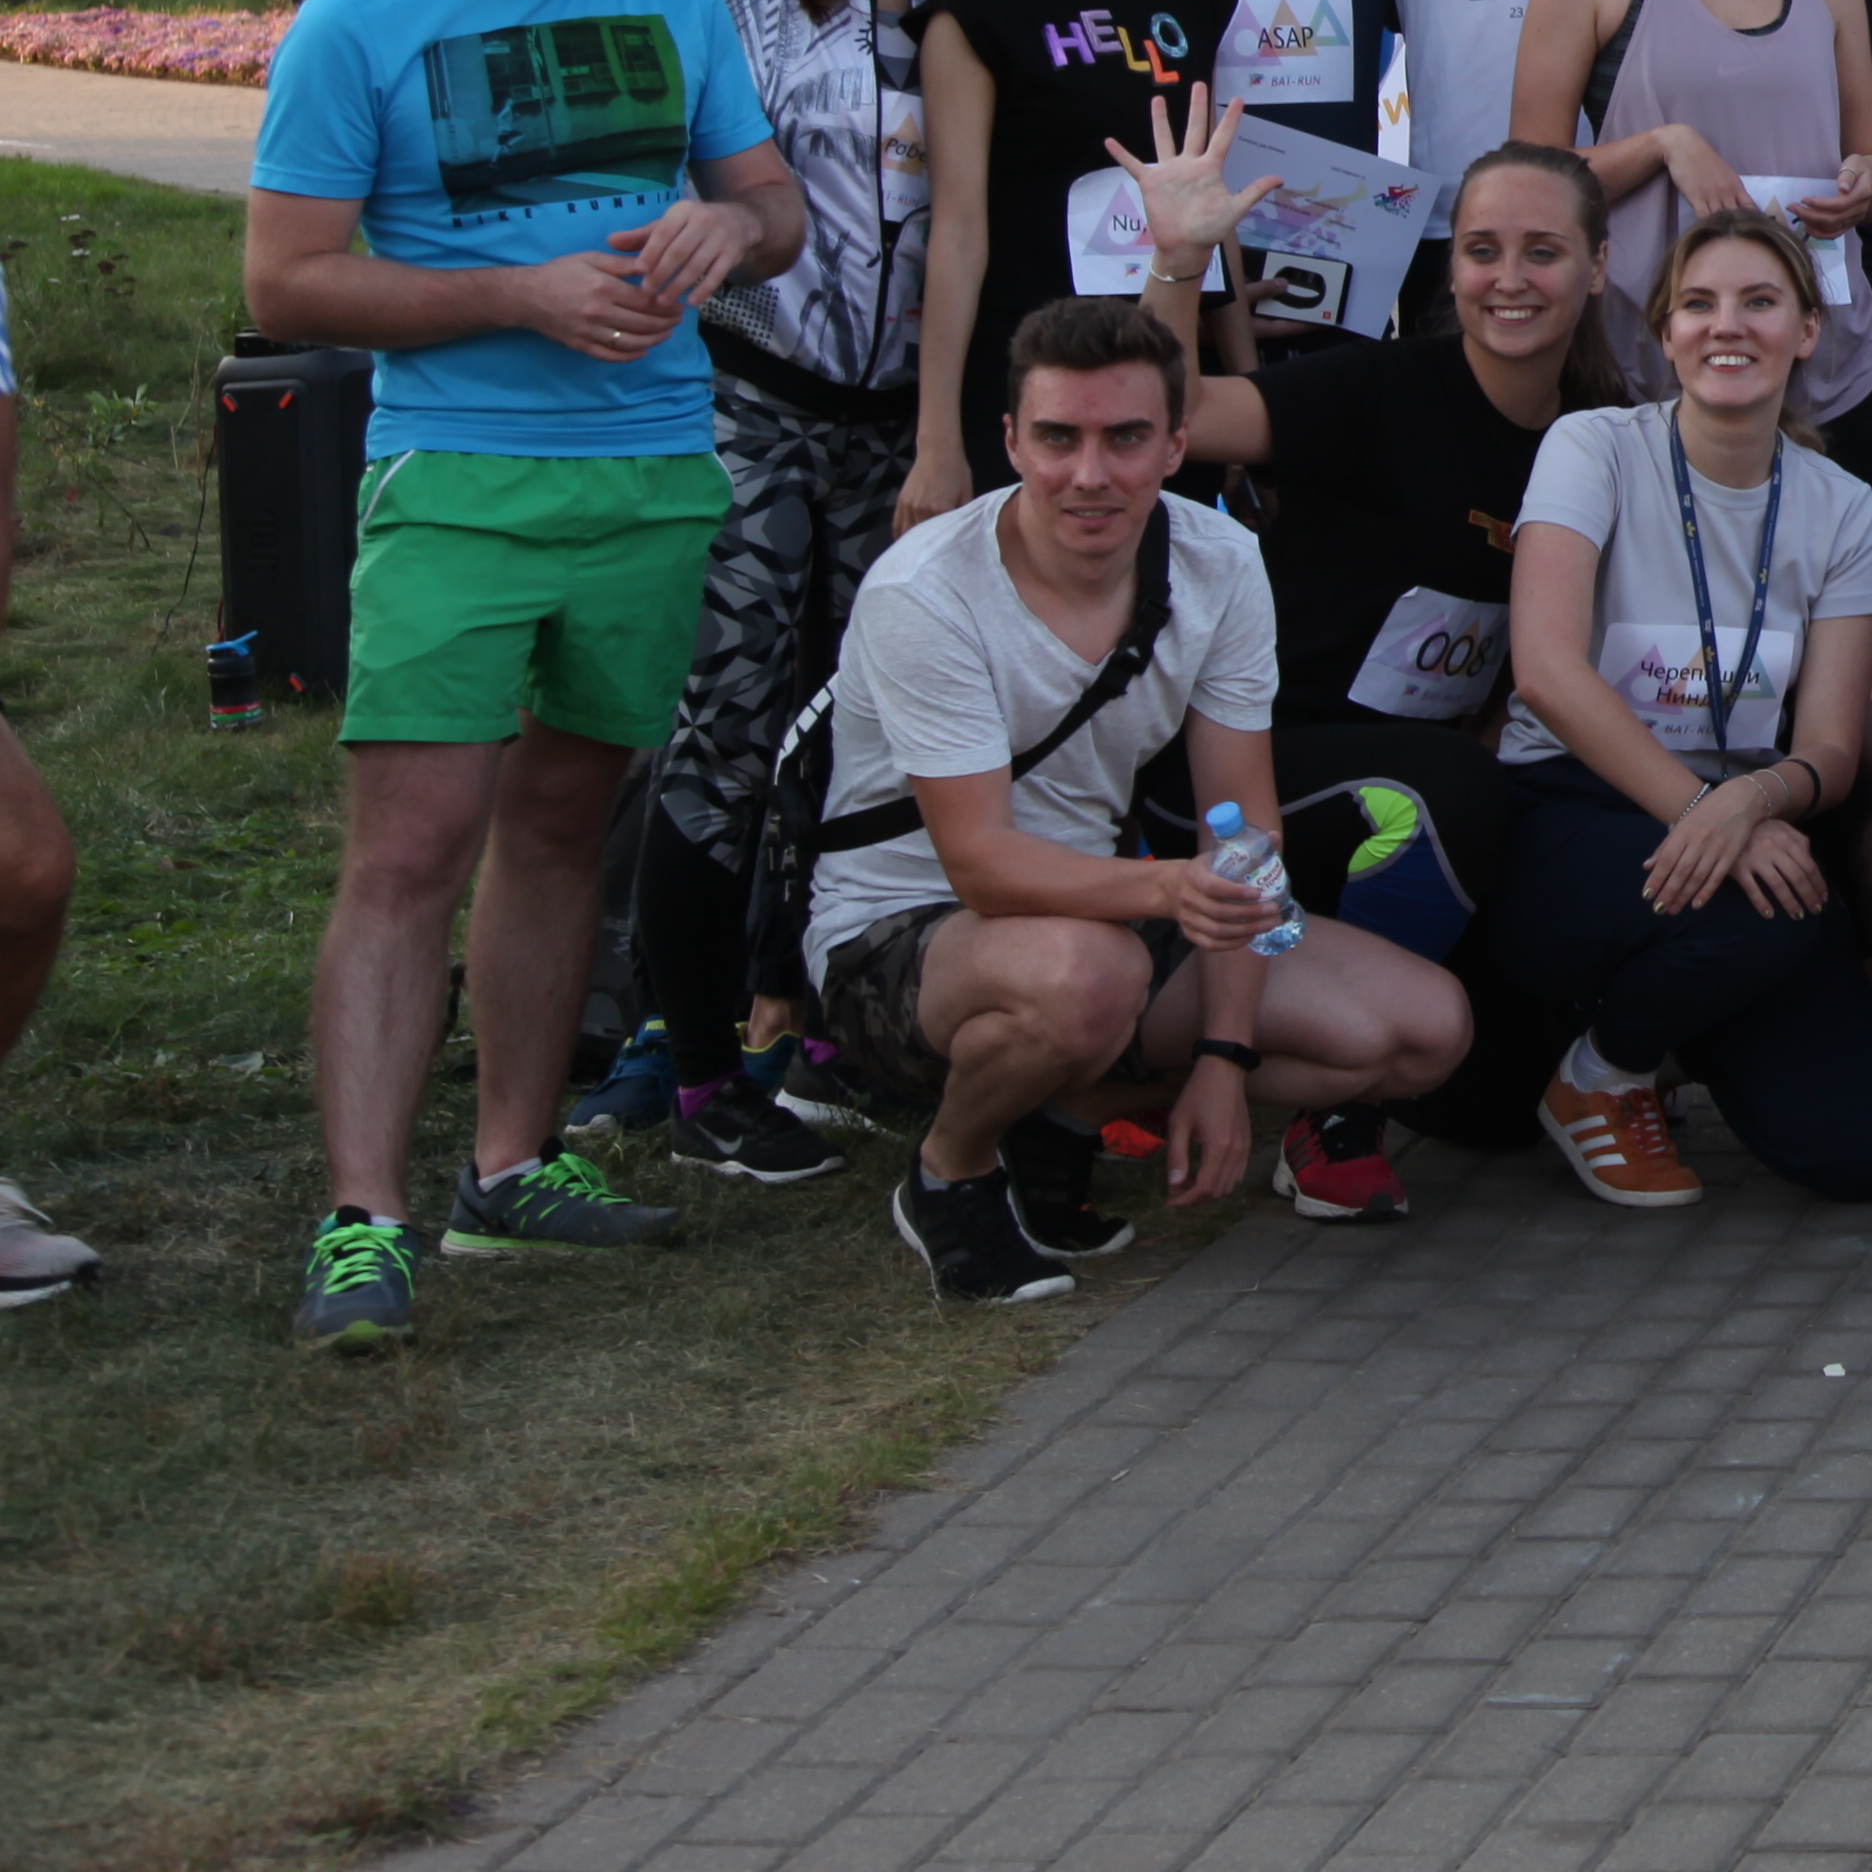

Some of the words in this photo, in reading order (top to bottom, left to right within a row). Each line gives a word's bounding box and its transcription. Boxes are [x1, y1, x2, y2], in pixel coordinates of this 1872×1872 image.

[1043, 9, 1190, 85] HELLO
[1258, 26, 1314, 50] ASAP
[1270, 74, 1322, 88] BAT-RUN
[1415, 630, 1494, 678] 008
